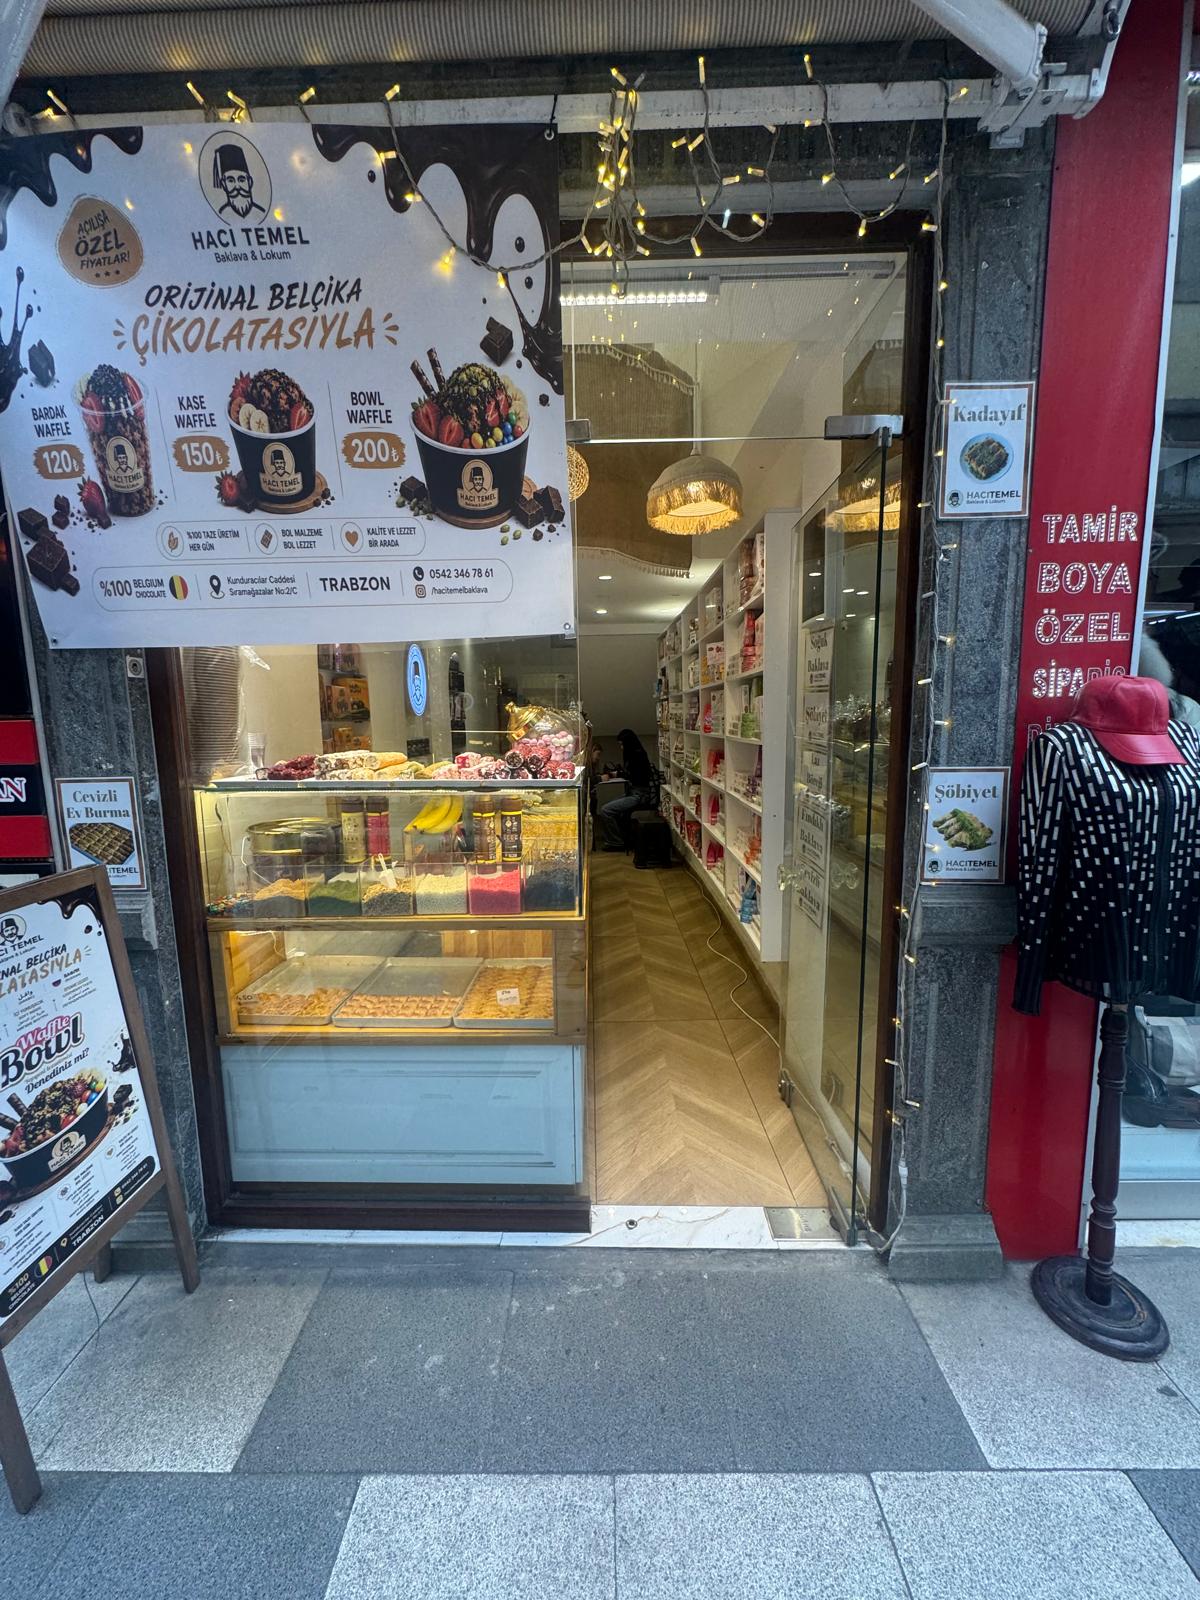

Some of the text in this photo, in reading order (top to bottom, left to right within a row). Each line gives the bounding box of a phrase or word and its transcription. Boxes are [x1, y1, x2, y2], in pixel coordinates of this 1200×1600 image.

[78, 209, 111, 236] AÇILIŞA
[75, 228, 125, 257] ÖZEL
[191, 226, 310, 250] HACI TEMEL
[214, 250, 291, 264] Baklava & Lokum
[144, 275, 363, 313] ORİJİNAL BELÇİKA
[131, 307, 376, 368] ÇİKOLATASIYLA
[177, 395, 207, 411] KASE
[350, 391, 385, 406] BOWL
[31, 405, 67, 421] BARDAK
[174, 413, 217, 429] WAFFLE
[346, 409, 393, 424] WAFFLE
[953, 404, 1026, 426] Kadayıf
[33, 421, 72, 438] WAFFLE
[460, 493, 496, 502] HACI TEMEL
[367, 526, 416, 536] KALİTE VE LEZZET
[1042, 504, 1138, 544] TAMİR
[203, 531, 217, 539] TAZE
[218, 529, 240, 539] ÜRETİM
[281, 528, 323, 537] BOL MALZEME
[189, 542, 215, 551] HER GÜN
[284, 541, 316, 549] BOL LEZZET
[368, 538, 399, 548] BİR ARADA
[227, 574, 296, 585] Kunduracılar Caddesi
[429, 568, 494, 579] 0542 346 78 61
[1036, 562, 1133, 595] BOYA
[99, 579, 133, 597] %100
[133, 578, 164, 589] BELGIUM
[274, 586, 298, 595] No:2/C
[319, 576, 391, 592] TRABZON
[431, 585, 488, 596] /hacitemelbaklava
[135, 590, 166, 598] CHOCOLATE
[1034, 608, 1130, 645] ÖZEL
[72, 789, 118, 803] Cevizli
[934, 783, 998, 803] Şöbiyet
[66, 807, 130, 819] Ev Burma
[108, 866, 139, 874] ITEMEL
[945, 860, 998, 868] HACITEMEL
[10, 934, 44, 952] TEMEL
[26, 943, 67, 970] BELÇİKA
[0, 948, 82, 998] LATASIYLA
[16, 1015, 70, 1051] Waffle
[0, 1014, 83, 1090] Bowl
[25, 1060, 73, 1094] Denediniz
[71, 1214, 104, 1247] TRABZON
[8, 1273, 29, 1294] %100
